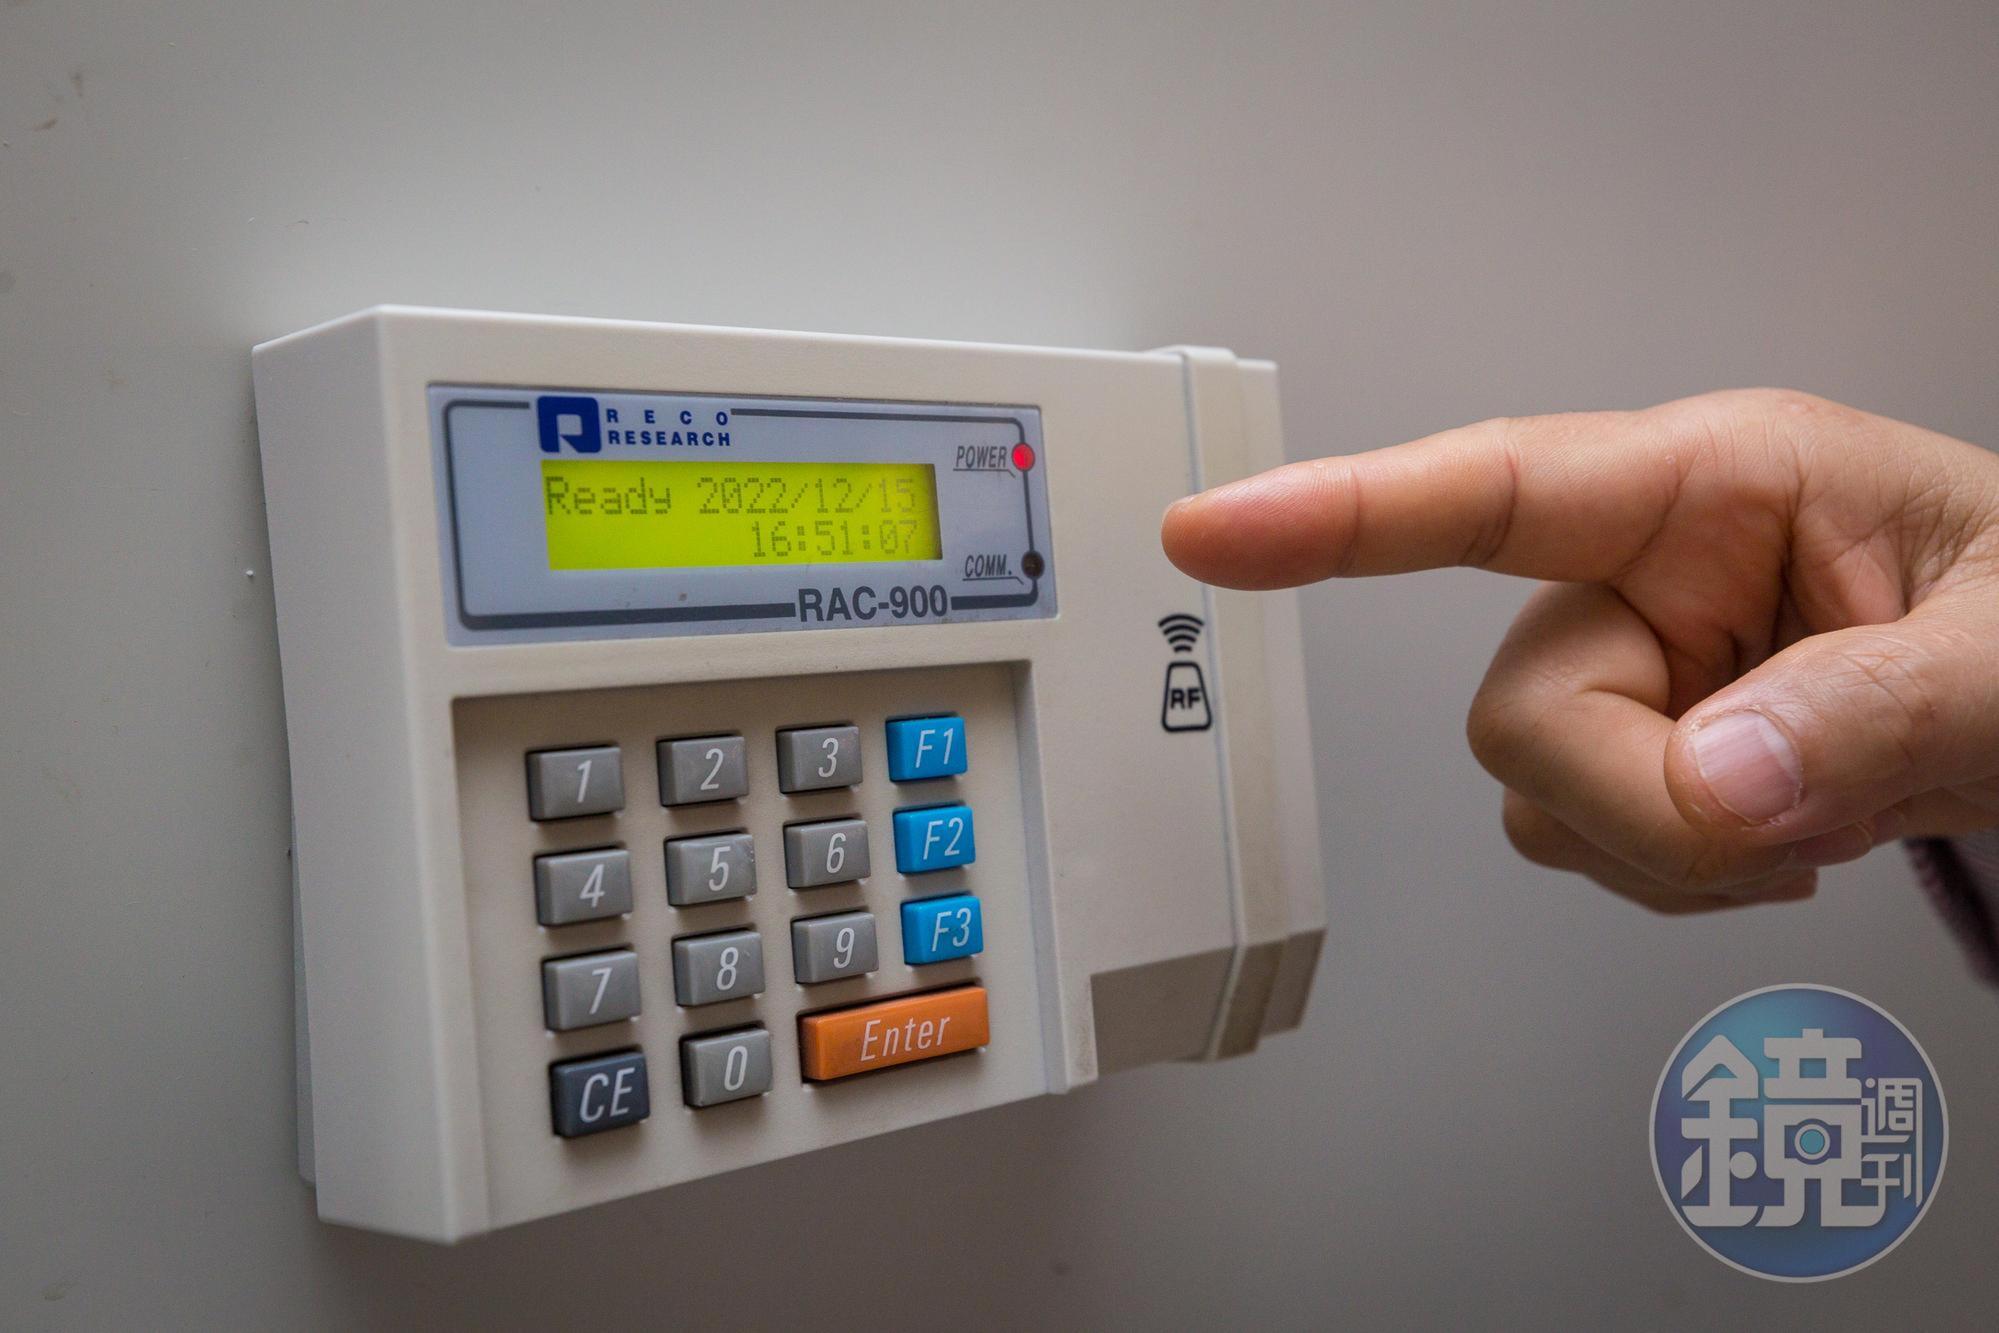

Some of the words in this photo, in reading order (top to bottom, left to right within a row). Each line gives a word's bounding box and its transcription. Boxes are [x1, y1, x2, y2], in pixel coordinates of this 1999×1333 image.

[608, 430, 731, 446] RESEARCH
[956, 446, 1008, 469] POWER
[544, 475, 672, 516] Ready
[698, 476, 916, 515] 2022/12/15
[750, 519, 919, 558] 16:51:07
[964, 555, 1013, 579] COMM.
[798, 585, 949, 623] RAC-900
[1170, 687, 1201, 710] RF
[818, 737, 839, 778] 3
[914, 727, 954, 768] F1
[576, 760, 592, 803] 1
[701, 748, 724, 790] 2
[826, 832, 847, 873] 6
[922, 817, 964, 860] F2
[580, 864, 606, 908] 4
[708, 846, 731, 891] 5
[833, 928, 855, 969] 9
[931, 907, 972, 952] F3
[716, 946, 739, 991] 8
[588, 968, 611, 1015] 7
[860, 1016, 952, 1062] Enter
[724, 1046, 747, 1092] 0
[579, 1067, 635, 1123] CE
